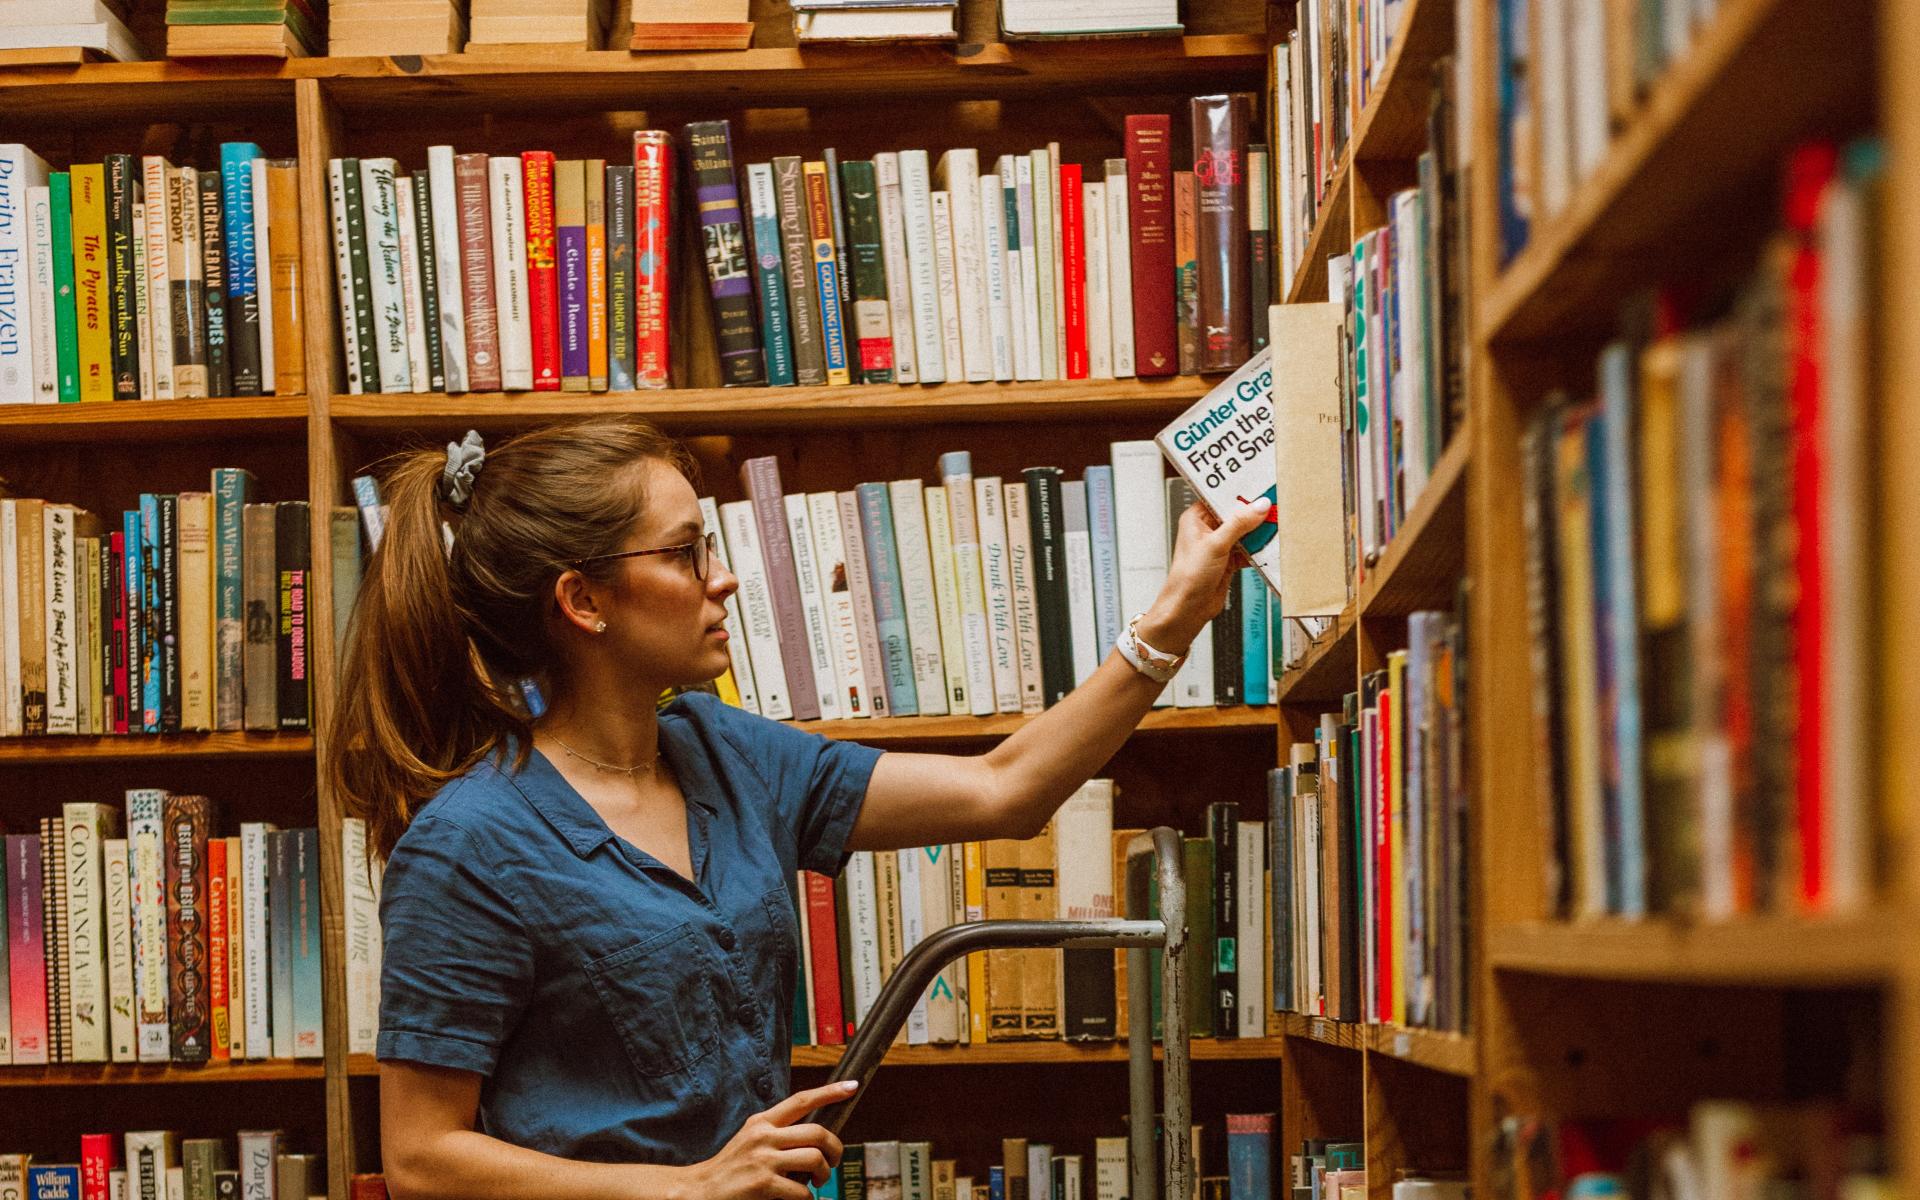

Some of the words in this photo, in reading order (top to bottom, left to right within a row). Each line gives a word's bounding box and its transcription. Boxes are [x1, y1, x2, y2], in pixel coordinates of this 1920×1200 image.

[0, 157, 15, 235] Purity
[83, 176, 94, 204] Fraser
[111, 161, 123, 194] Michael
[147, 163, 164, 230] MICHAEL
[225, 161, 239, 226] CHARLES
[239, 161, 254, 214] COLD
[615, 174, 624, 205] AMITAV
[777, 161, 800, 231] Storming
[112, 195, 124, 220] Frayn
[169, 176, 184, 245] ENTROPY
[183, 178, 197, 241] AGAINST
[418, 175, 432, 252] EXTRAORDINARY
[525, 160, 540, 235] CHROMOSOME
[541, 182, 552, 235] CALCUTTA
[35, 202, 48, 238] Caro
[114, 232, 126, 243] A
[203, 192, 220, 245] MICHAEL
[384, 222, 398, 239] the
[615, 206, 625, 238] GHOSH
[83, 235, 100, 262] The
[135, 237, 146, 259] THE
[149, 234, 168, 281] FRAYN
[989, 225, 999, 258] ELLEN
[37, 243, 51, 287] Fraser
[114, 244, 130, 295] Landing
[136, 263, 146, 282] TIN
[206, 250, 222, 288] FRAYN
[228, 232, 241, 292] FRAZIER
[241, 221, 258, 323] MOUNTAIN
[424, 254, 434, 292] PEOPLE
[565, 248, 579, 291] Circle
[590, 247, 603, 299] Shadow
[613, 271, 624, 289] THE
[787, 234, 807, 289] Heaven
[82, 269, 101, 330] Pyrates
[821, 264, 836, 298] GOOD
[991, 262, 1001, 301] FOSTER
[0, 248, 19, 355] Franzen
[117, 294, 128, 310] on
[136, 285, 147, 316] MEN
[614, 292, 626, 333] HUNGRY
[636, 284, 651, 338] Poppies
[650, 291, 662, 316] Sea
[825, 299, 839, 327] KING
[118, 311, 131, 330] the
[208, 308, 225, 346] SPIES
[568, 303, 580, 351] Reason
[591, 302, 604, 341] Lines
[650, 318, 663, 332] of
[797, 296, 811, 345] GIARDINA
[118, 331, 132, 357] Sun
[615, 336, 626, 361] TIDE
[827, 328, 843, 367] HARRY
[1173, 397, 1238, 452] Günter
[1236, 370, 1272, 403] Gra
[1319, 413, 1340, 424] PEE
[1186, 430, 1240, 473] From
[1235, 405, 1271, 435] the
[1205, 462, 1226, 489] of
[1225, 457, 1242, 473] a
[1237, 426, 1275, 462] Sna
[218, 473, 237, 498] Rip
[984, 485, 995, 517] Gilchrist
[1008, 487, 1020, 518] Gilchrist
[1039, 478, 1050, 501] ELLEN
[163, 500, 172, 545] Columbus
[223, 501, 238, 526] Van
[1040, 501, 1052, 540] GILCHRIST
[1097, 479, 1110, 537] GILCHRIST
[223, 528, 239, 579] Winkle
[987, 543, 1006, 590] Drunk
[1012, 544, 1032, 592] Drunk
[1101, 548, 1110, 556] A
[128, 555, 139, 607] COLUMBUS
[164, 547, 173, 598] Slaughters
[291, 570, 304, 587] THE
[961, 571, 974, 605] Stories
[1102, 558, 1115, 624] DANGEROUS
[165, 600, 174, 632] Braves
[291, 588, 304, 611] ROAD
[991, 594, 1008, 631] With
[1016, 596, 1035, 633] With
[291, 613, 304, 626] TO
[838, 601, 859, 676] RHODA
[966, 613, 978, 638] Ellen
[1106, 626, 1116, 647] AGE
[129, 609, 138, 672] SLAUGHTERS
[996, 635, 1010, 669] Love
[1020, 637, 1035, 671] Love
[886, 634, 905, 688] Gilchrist
[914, 646, 926, 682] Gilchrist
[928, 652, 939, 674] Ellen
[969, 640, 983, 684] Gilchrist
[130, 673, 139, 712] BRAVES
[178, 824, 193, 865] DESTINY
[248, 832, 256, 849] The
[247, 854, 257, 892] Crystal
[953, 859, 961, 911] ELPENOR
[70, 824, 90, 971] CONSTANCIA
[110, 860, 126, 970] CONSTANCIA
[180, 886, 194, 922] DESIRE
[211, 876, 225, 932] CARLOS
[886, 891, 895, 919] ISLAND
[1067, 906, 1114, 920] MILLION
[1093, 894, 1114, 908] ONE
[145, 914, 156, 954] CARLOS
[182, 929, 195, 970] CARLOS
[148, 958, 159, 1005] FUENTES
[212, 936, 225, 1000] FUENTES
[251, 986, 259, 1025] FUENTES
[215, 1011, 229, 1045] USED
[0, 1160, 21, 1171] illiam
[36, 1171, 71, 1187] William
[85, 1157, 94, 1185] ARE
[95, 1156, 106, 1188] JUST
[139, 1154, 156, 1200] METROP
[38, 1184, 69, 1199] Gaddis
